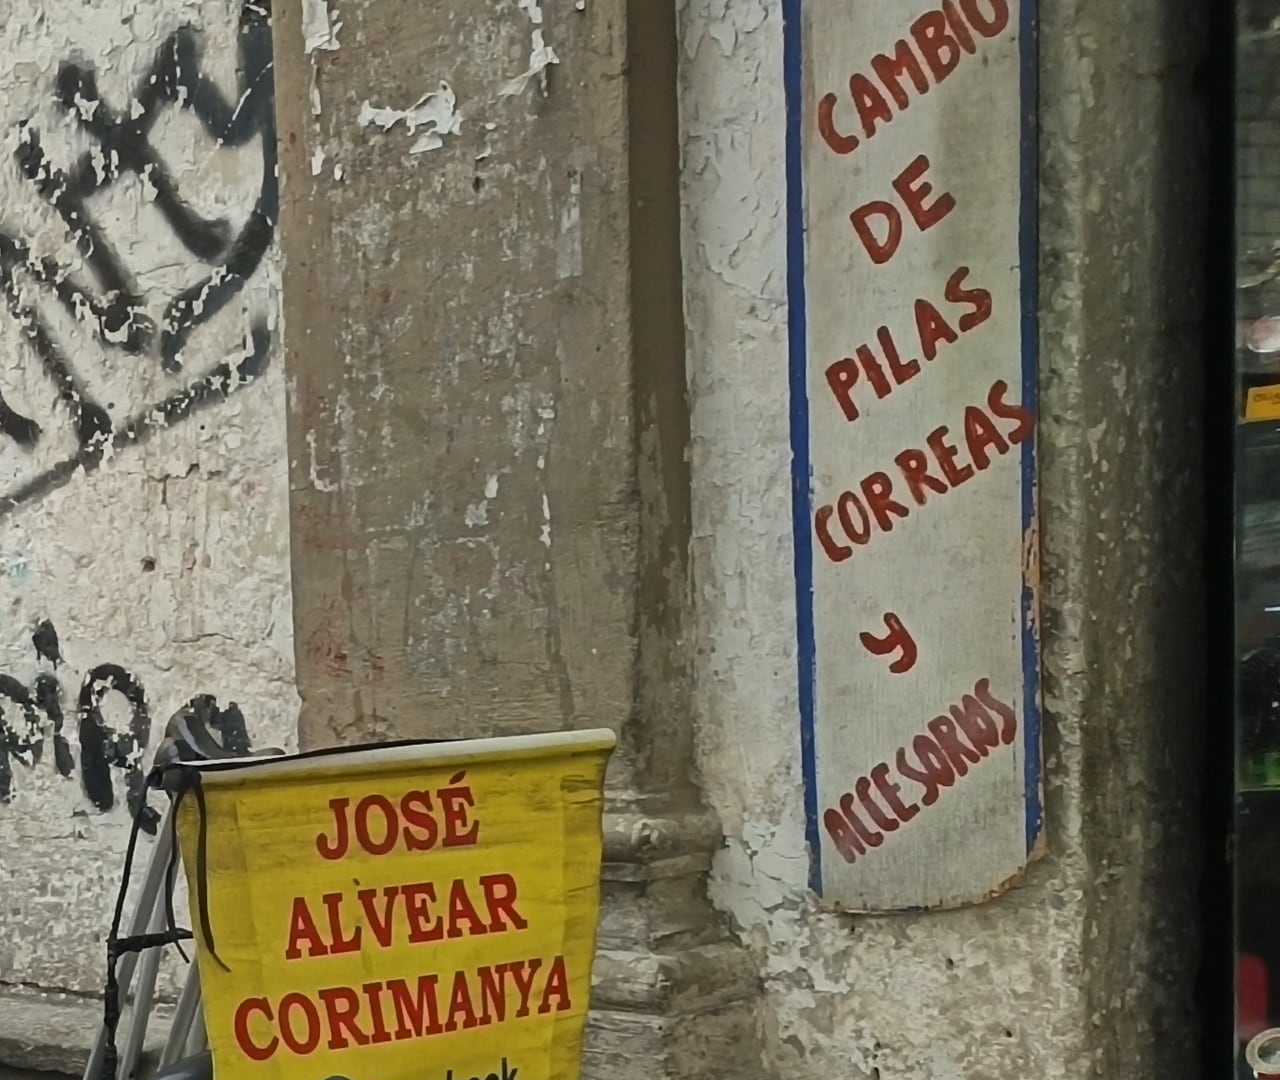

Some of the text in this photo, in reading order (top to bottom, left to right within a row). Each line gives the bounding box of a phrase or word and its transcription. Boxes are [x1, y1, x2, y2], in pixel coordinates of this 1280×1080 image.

[850, 154, 957, 266] DE
[825, 266, 993, 422] PILAS
[815, 379, 1036, 563] CORREAS
[315, 770, 480, 861] JOSÉ
[822, 677, 1018, 864] ACCESORIOS
[285, 873, 528, 960] ALVEAR
[233, 955, 572, 1061] CORIMANYA
